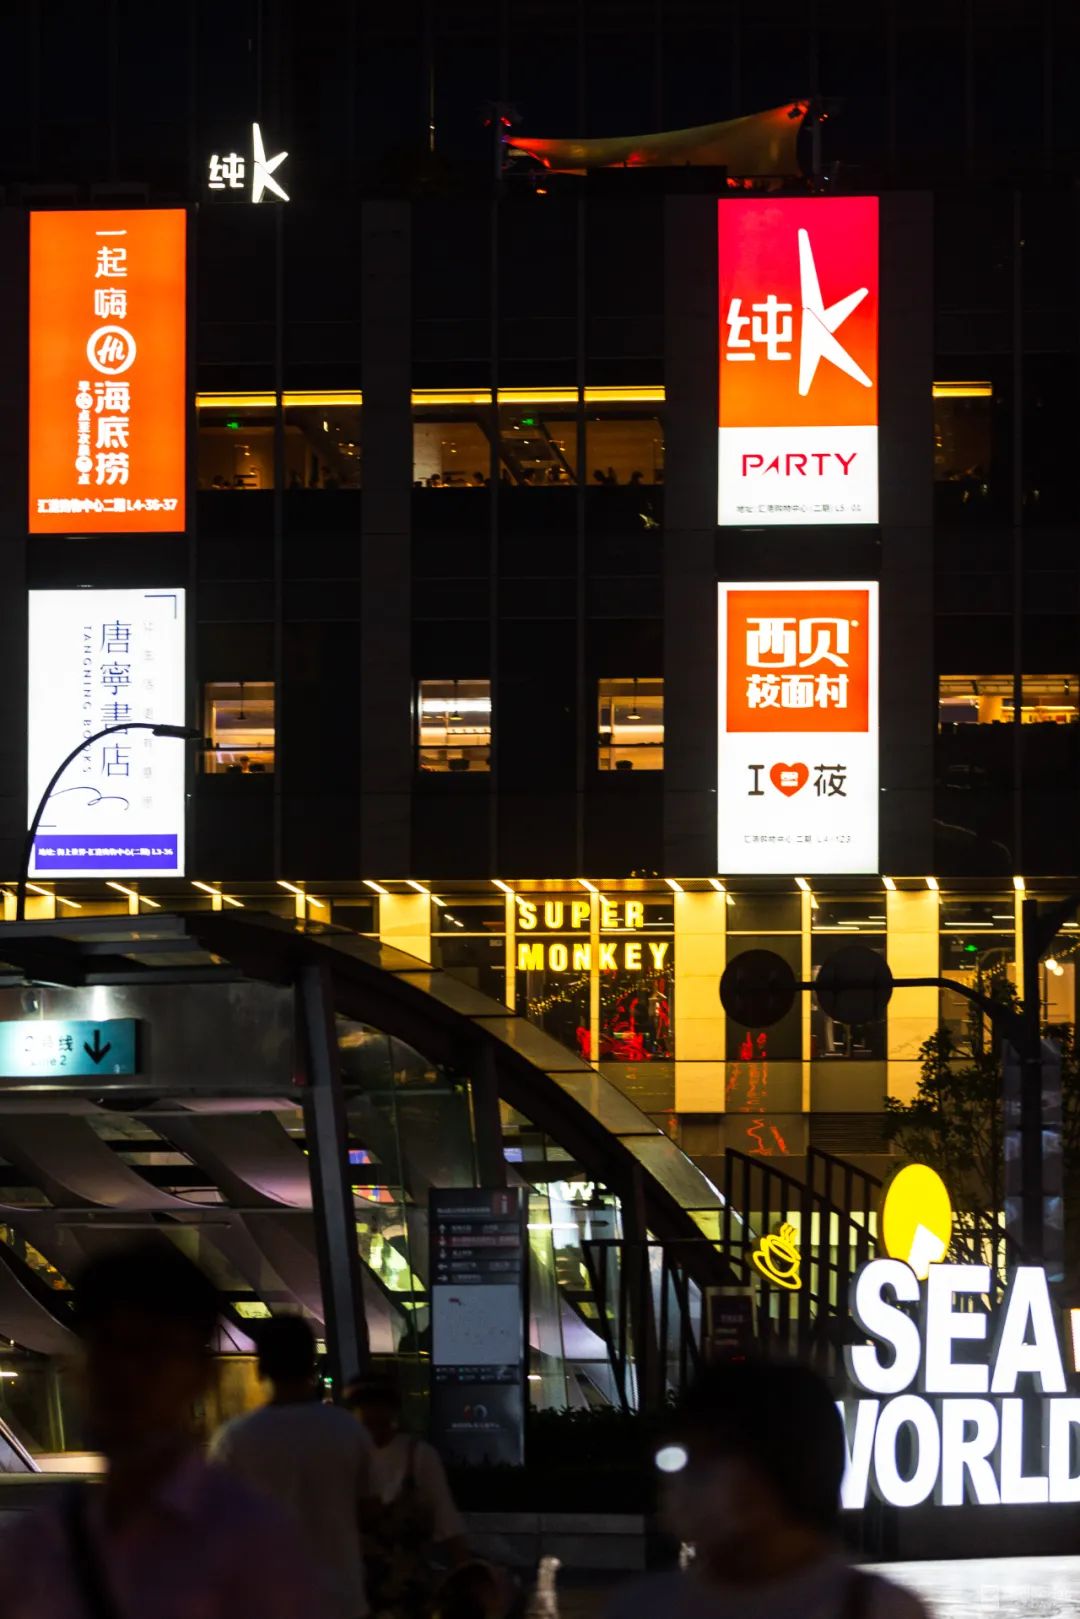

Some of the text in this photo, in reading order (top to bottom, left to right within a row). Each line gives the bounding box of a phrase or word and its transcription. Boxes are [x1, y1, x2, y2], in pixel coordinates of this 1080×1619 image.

[94, 228, 128, 320] 一起嗨
[94, 380, 130, 485] 海底捞
[741, 452, 857, 477] PARTY
[746, 617, 849, 668] 西贝
[82, 625, 92, 709] TANGNING
[746, 673, 849, 708] 莜面村
[748, 764, 765, 797] I
[813, 763, 847, 798] 莜
[518, 900, 645, 930] SUPER
[518, 942, 669, 972] MONKEY
[851, 1258, 1068, 1395] SEA
